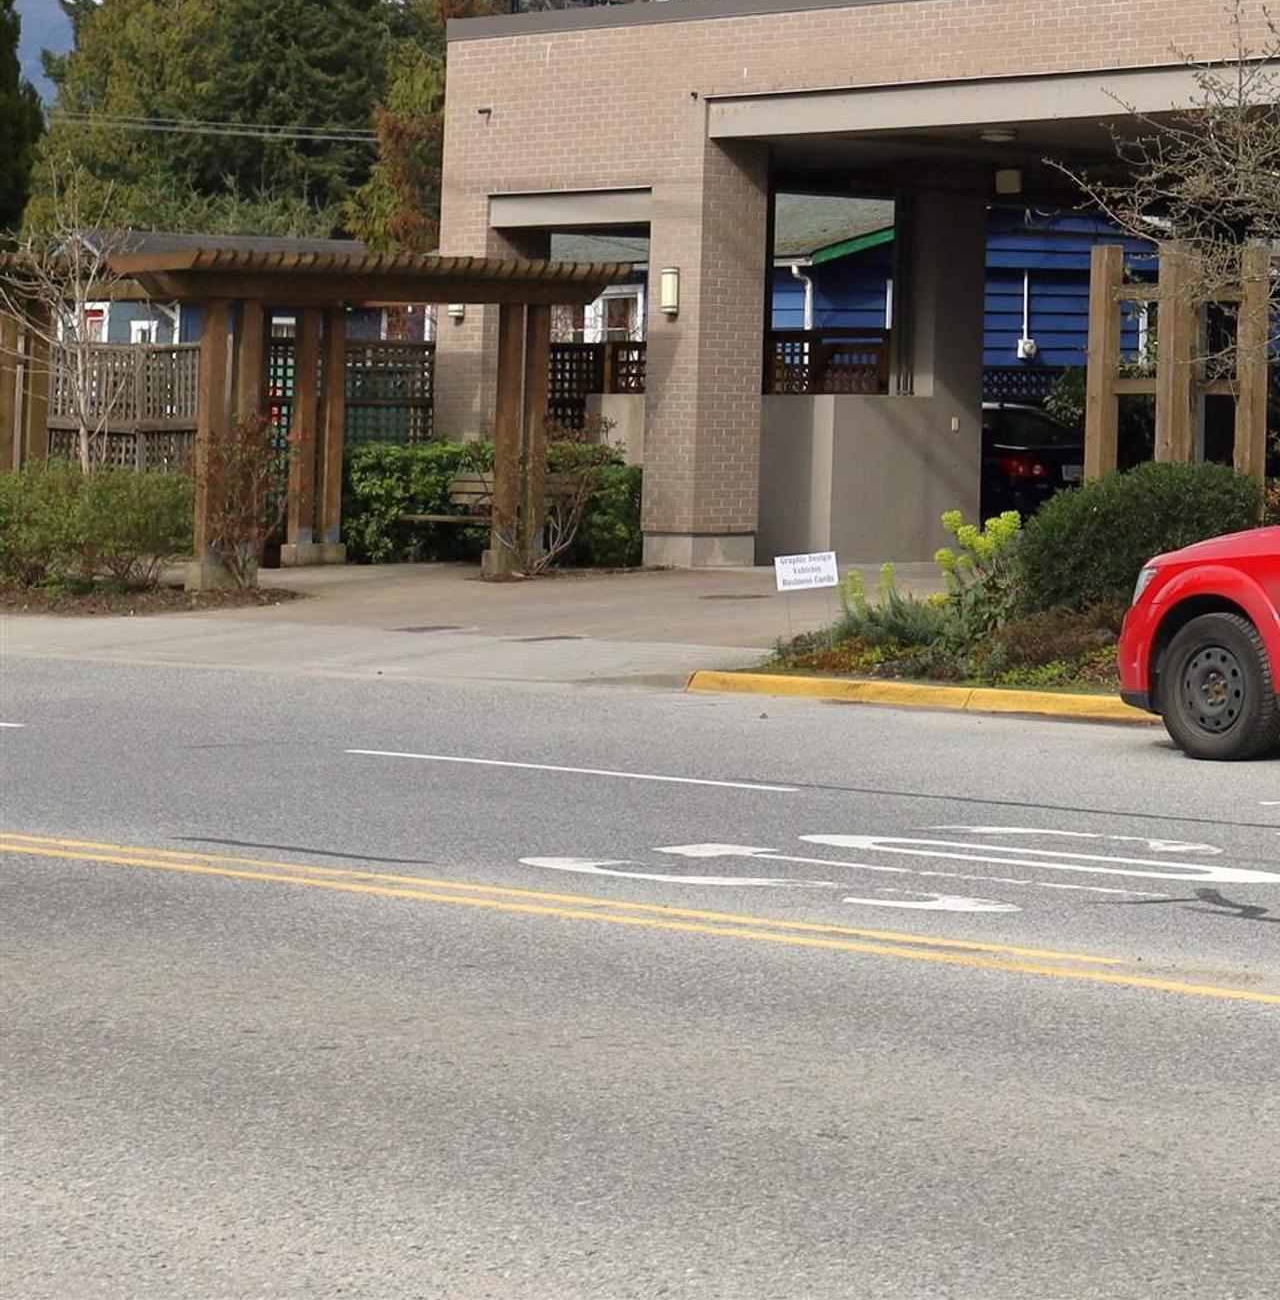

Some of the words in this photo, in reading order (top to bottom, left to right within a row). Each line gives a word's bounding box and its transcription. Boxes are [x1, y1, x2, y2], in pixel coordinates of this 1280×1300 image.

[780, 557, 807, 566] Graphic
[808, 554, 832, 563] Design
[793, 565, 821, 575] Vehicles
[782, 578, 812, 587] Business
[814, 574, 835, 584] Cards
